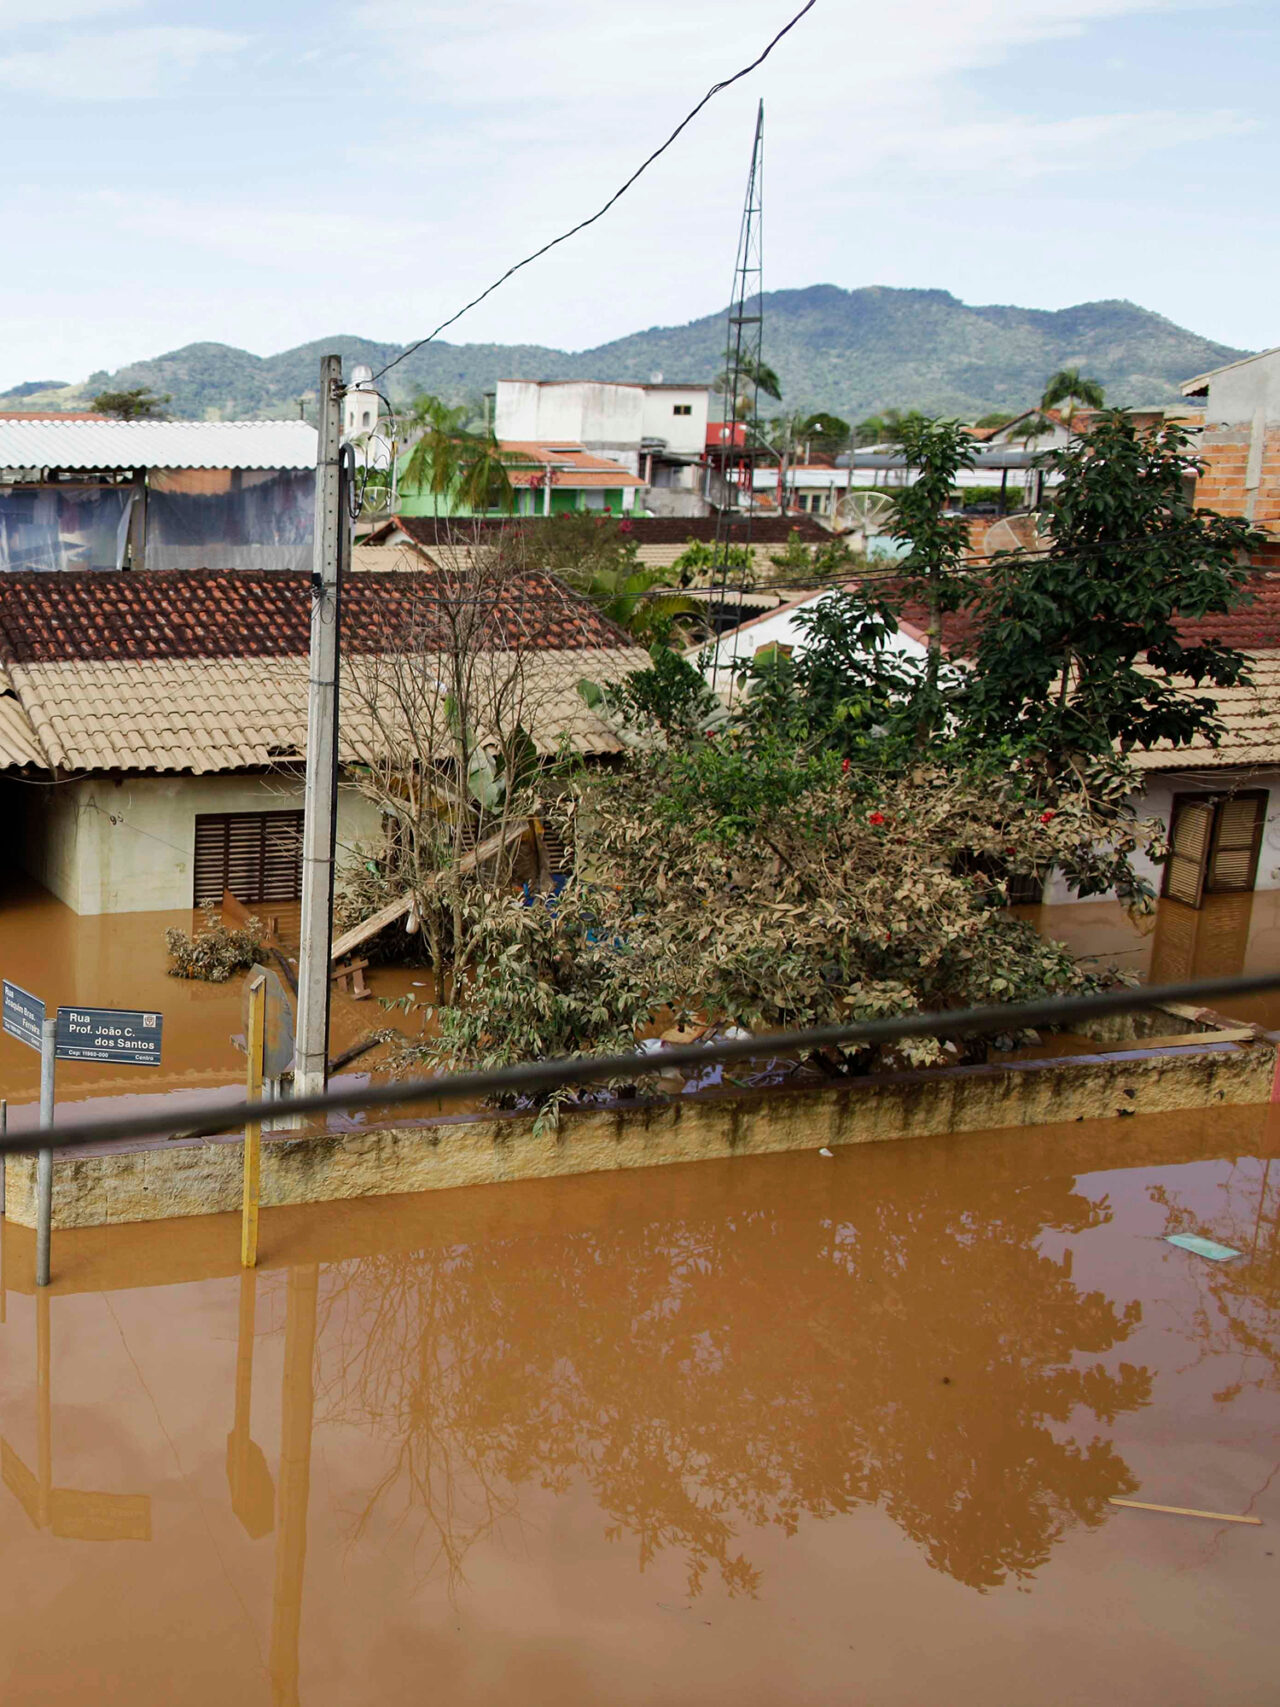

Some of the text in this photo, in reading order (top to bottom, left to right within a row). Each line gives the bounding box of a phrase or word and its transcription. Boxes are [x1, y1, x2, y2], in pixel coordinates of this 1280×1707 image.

[4, 986, 14, 998] Rua
[4, 997, 24, 1014] Joaquim
[70, 1013, 90, 1023] Rua
[69, 1024, 135, 1037] Prof. João C.
[95, 1037, 155, 1050] dos Santos
